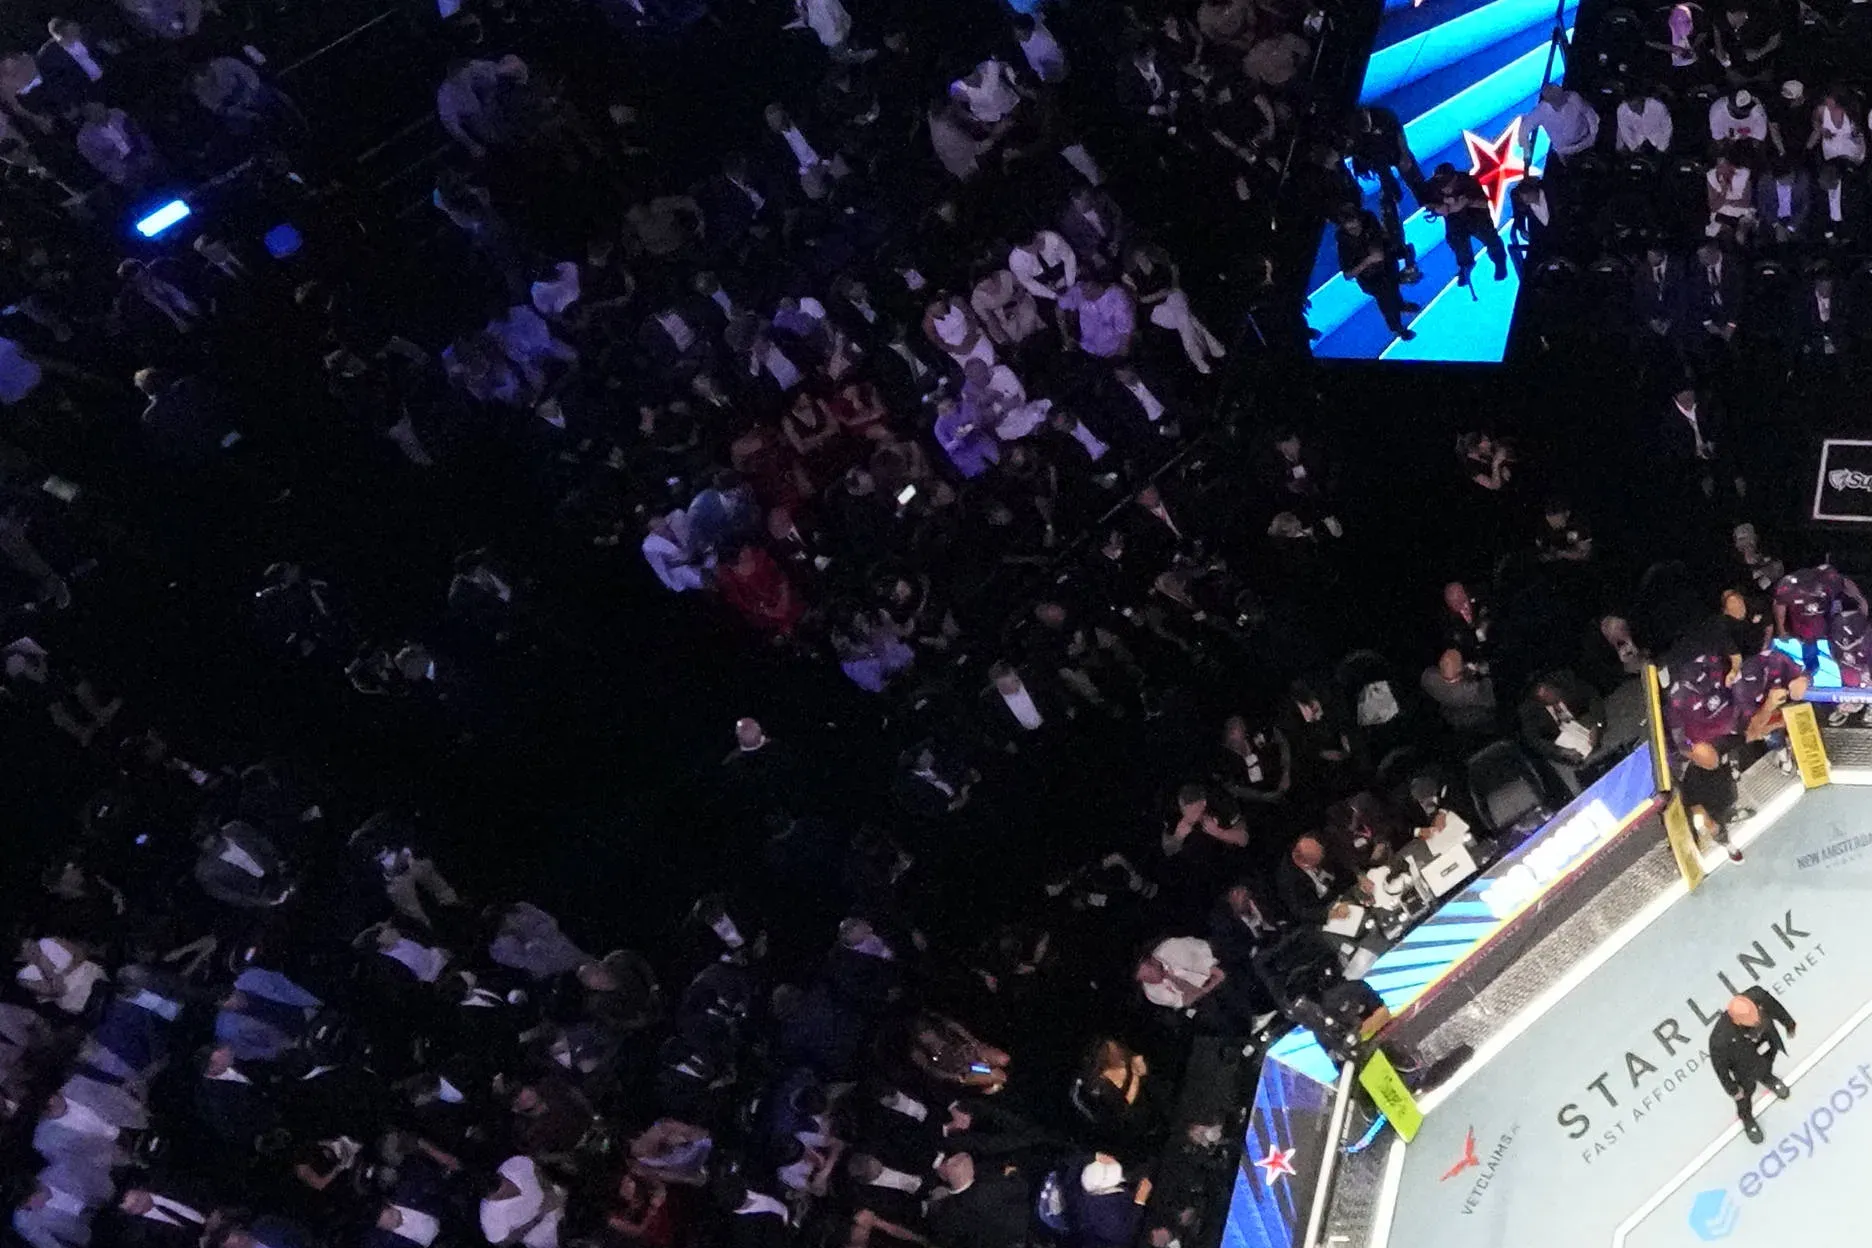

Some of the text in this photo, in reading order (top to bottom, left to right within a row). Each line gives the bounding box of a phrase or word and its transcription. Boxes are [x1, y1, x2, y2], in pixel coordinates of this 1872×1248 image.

[1797, 847, 1821, 870] NEW
[1557, 908, 1813, 1141] STARLINK
[1580, 1111, 1635, 1165] FAST
[1631, 1049, 1715, 1124] AFFORDA
[1461, 1135, 1513, 1216] VETCLAIMS
